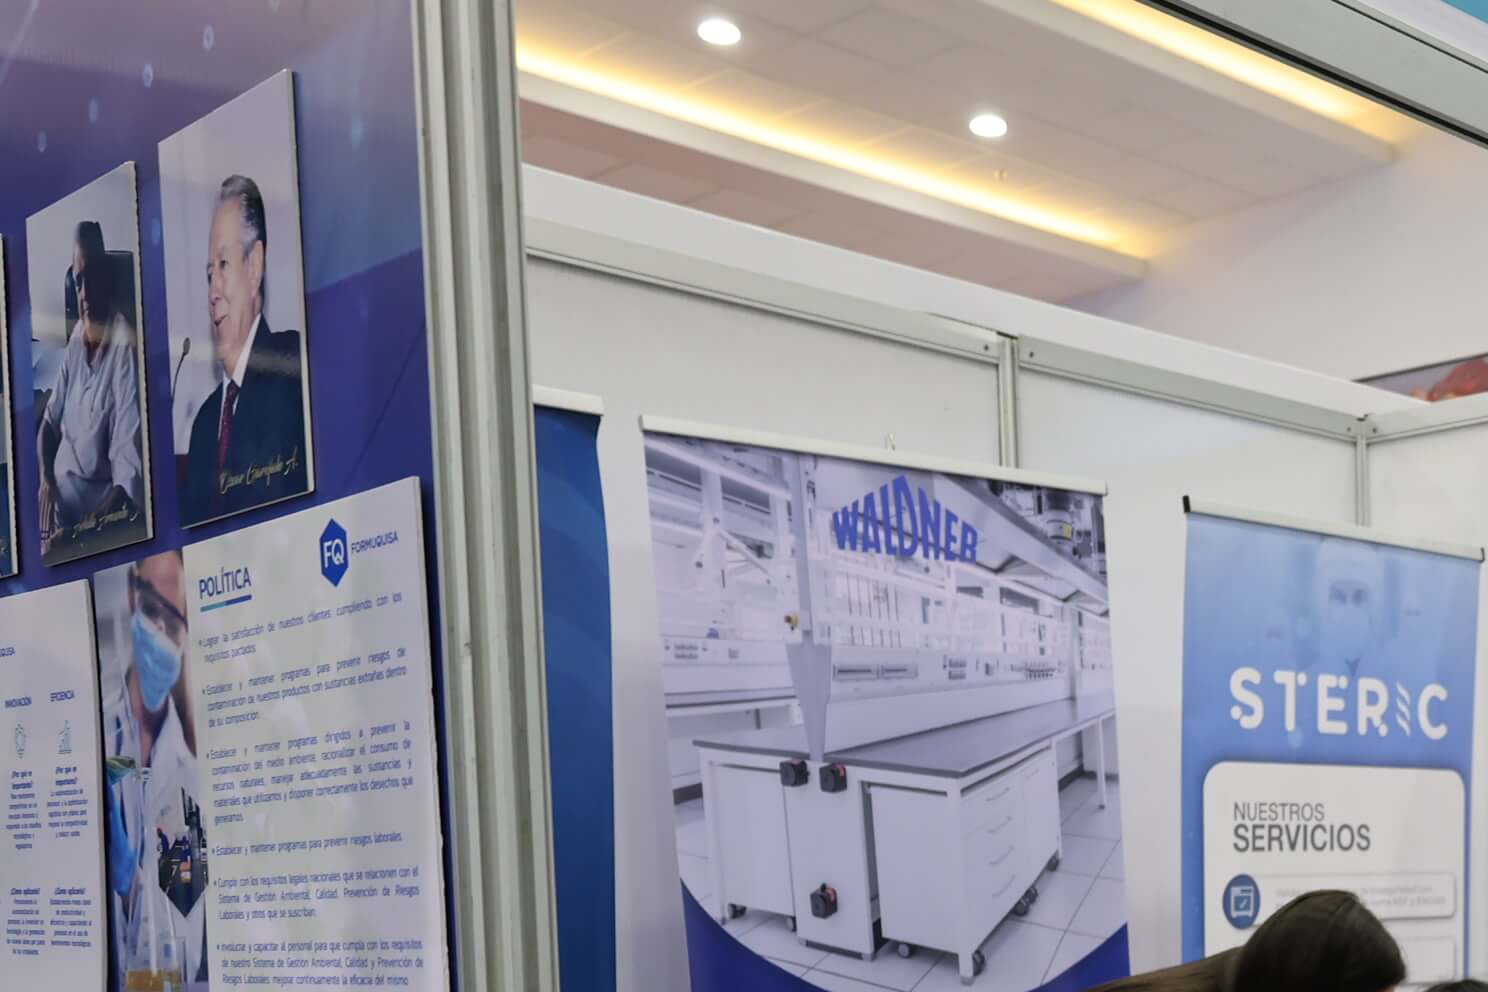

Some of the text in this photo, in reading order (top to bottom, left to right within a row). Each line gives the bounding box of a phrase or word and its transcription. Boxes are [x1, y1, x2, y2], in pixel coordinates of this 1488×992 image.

[832, 475, 978, 564] WALDNER
[323, 538, 344, 568] FQ
[199, 567, 252, 599] POLÍTICA
[1233, 802, 1325, 822] NUESTROS
[1233, 823, 1371, 853] SERVICIOS
